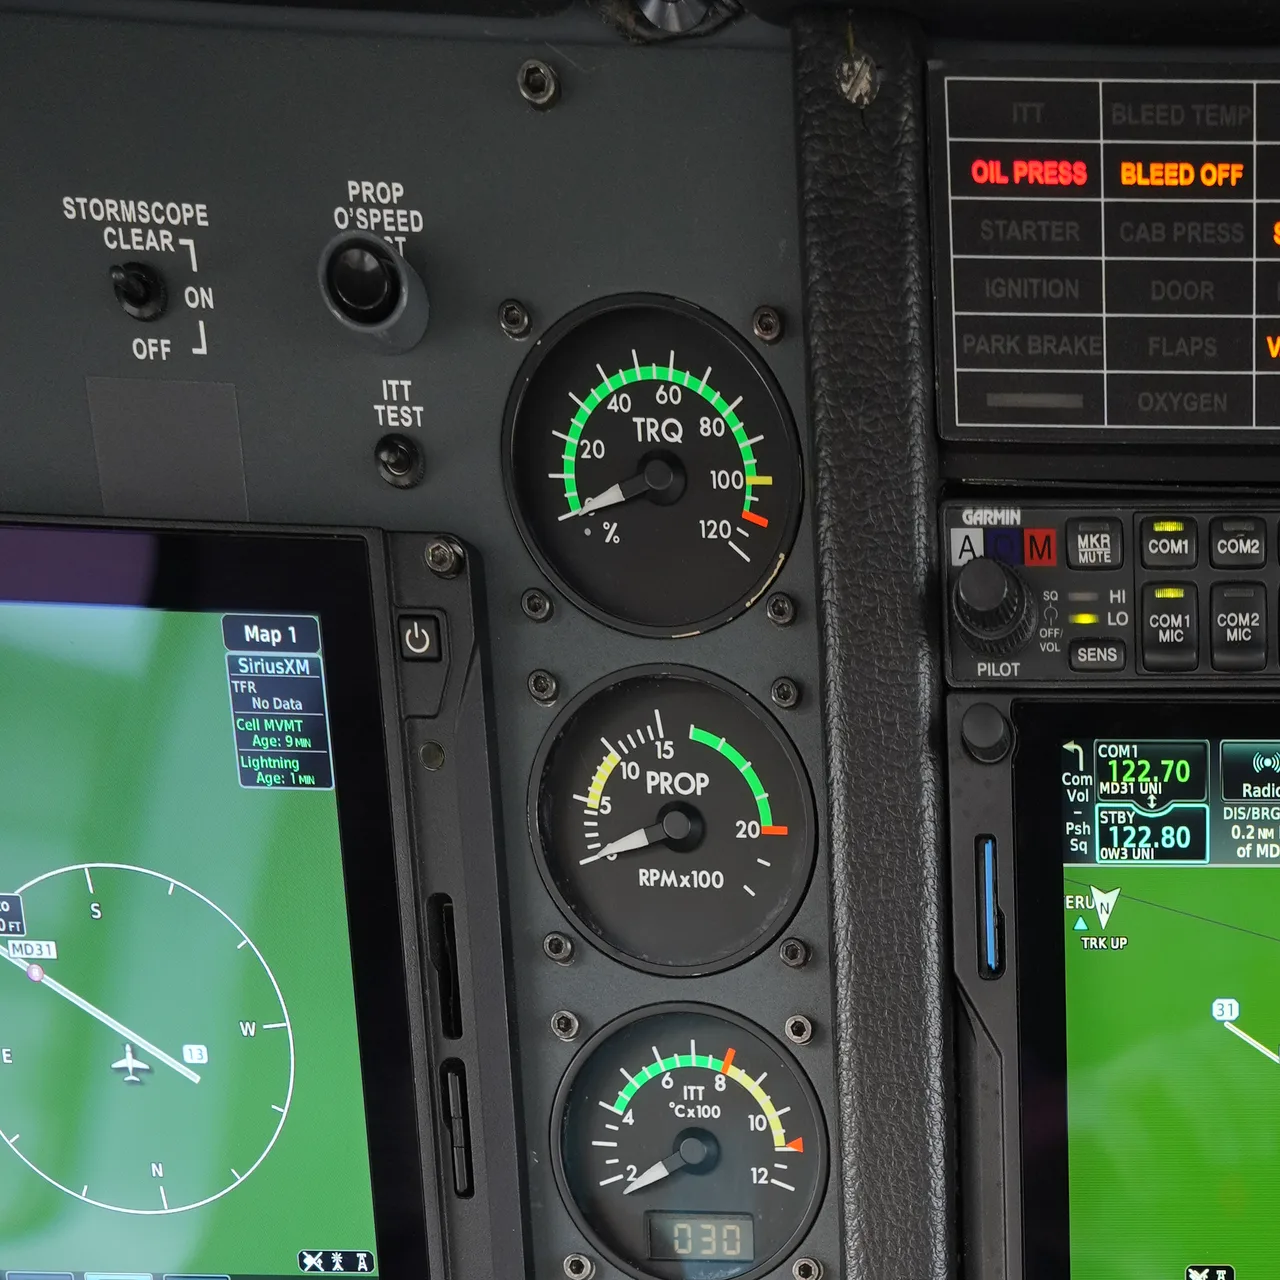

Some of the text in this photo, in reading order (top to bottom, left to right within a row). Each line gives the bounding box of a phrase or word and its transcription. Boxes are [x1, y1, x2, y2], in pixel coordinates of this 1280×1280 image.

[971, 160, 1088, 185] OIL PRESS
[1120, 162, 1244, 186] BLEED OFF
[348, 181, 404, 204] PROP
[62, 197, 209, 226] STORMSCOPE
[334, 207, 423, 232] O'SPEED
[104, 227, 175, 252] CLEAR
[185, 287, 214, 309] ON
[132, 338, 171, 360] OFF
[382, 380, 411, 401] ITT
[374, 405, 423, 427] TEST
[633, 417, 683, 443] TRQ
[710, 471, 743, 489] 100
[962, 509, 1020, 525] GARMIN
[1149, 540, 1188, 554] COM1
[1218, 540, 1259, 554] COM2
[244, 626, 296, 646] Map 1
[238, 658, 310, 675] SiriusXM
[978, 663, 1020, 676] PILOT
[1108, 760, 1190, 783] 122.70
[646, 771, 709, 795] PROP
[1109, 826, 1190, 848] 122.80
[684, 1086, 705, 1100] ITT
[674, 1223, 740, 1255] 030
